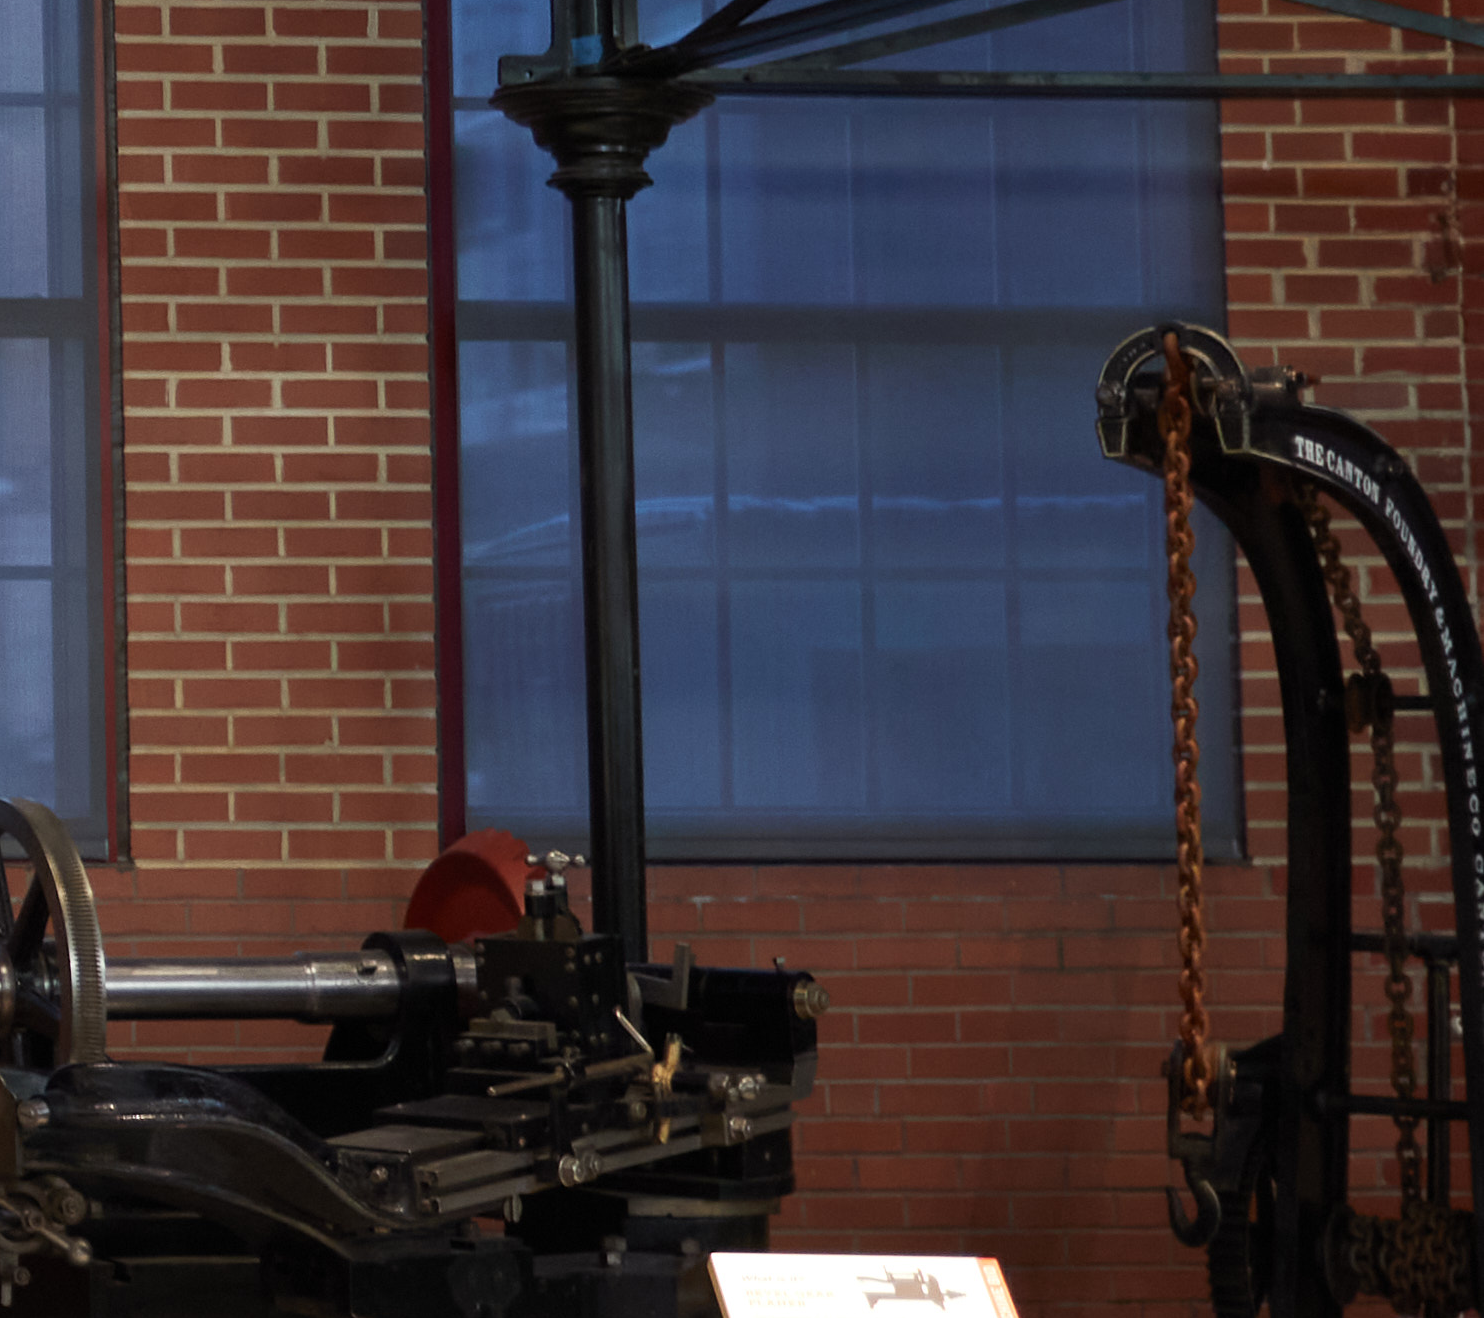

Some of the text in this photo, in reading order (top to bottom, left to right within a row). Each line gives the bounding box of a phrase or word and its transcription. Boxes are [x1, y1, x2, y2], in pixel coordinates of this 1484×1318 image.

[1294, 435, 1325, 467] THE
[1326, 449, 1381, 505] CANTON
[1384, 496, 1439, 602] FOUNDRY
[1435, 606, 1444, 629] &
[1440, 626, 1478, 789] MACHINE
